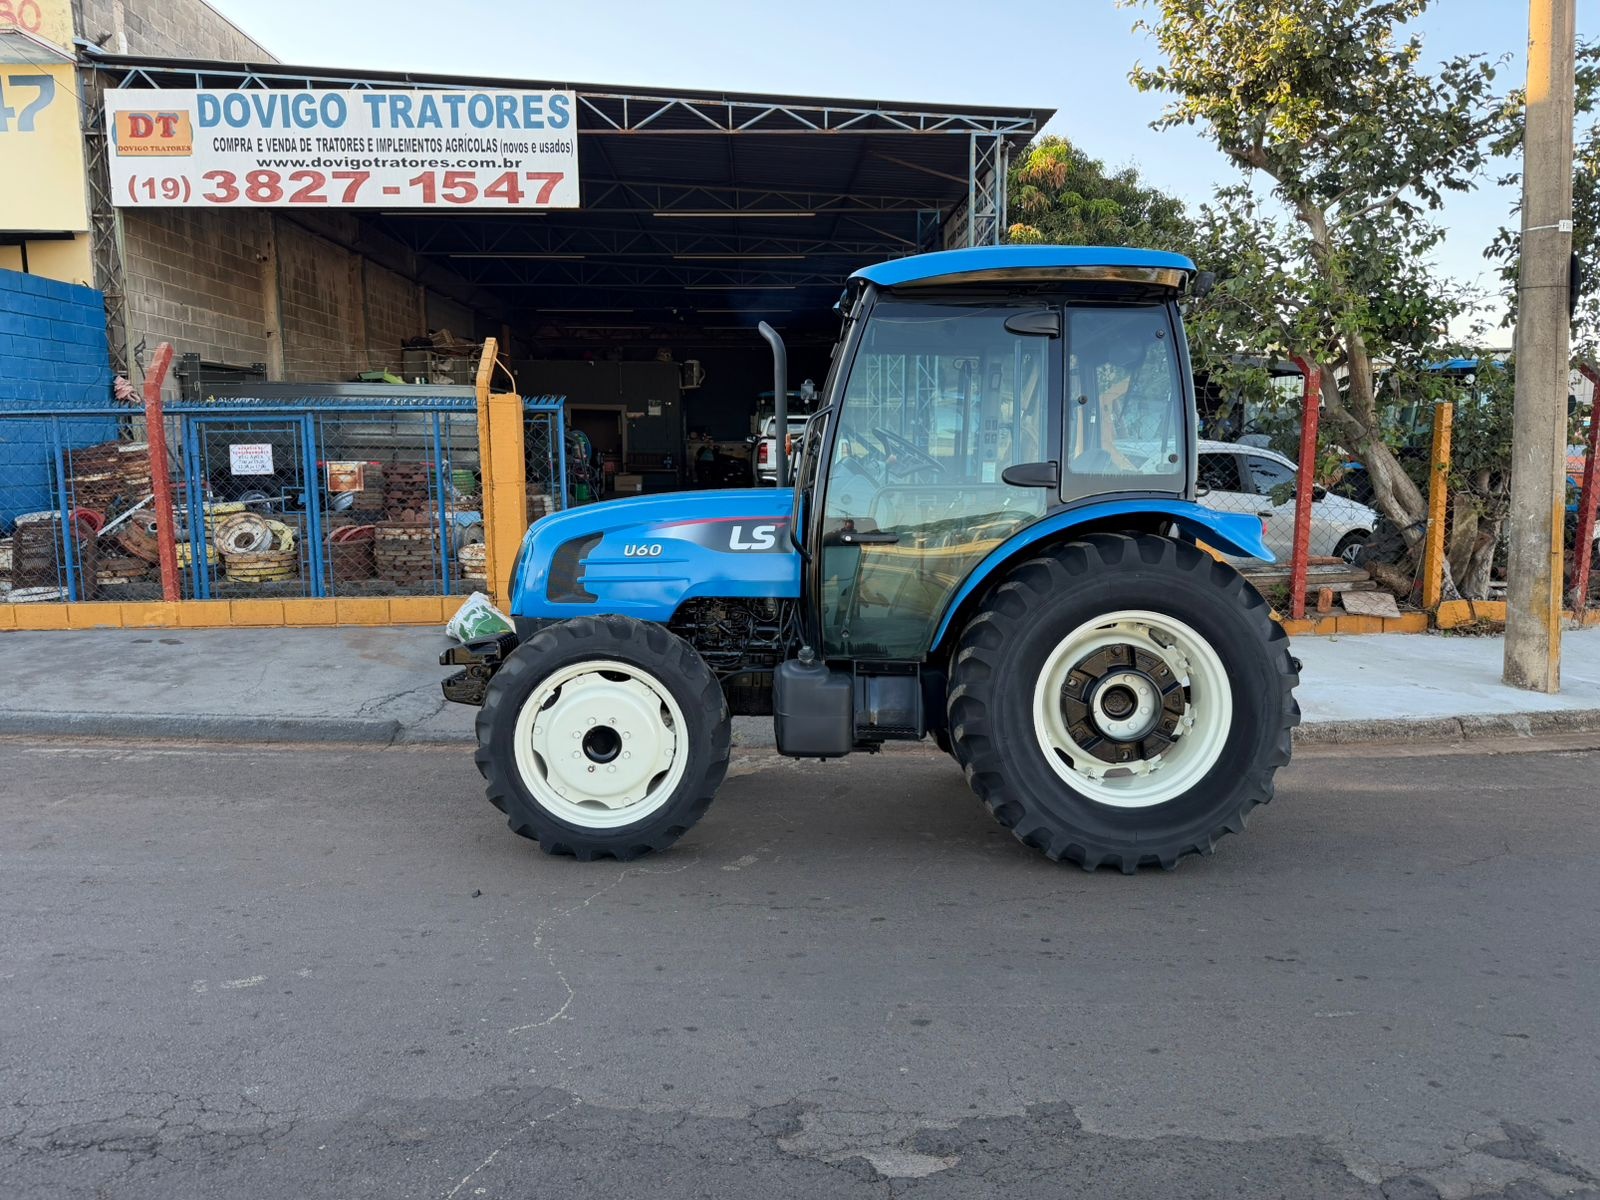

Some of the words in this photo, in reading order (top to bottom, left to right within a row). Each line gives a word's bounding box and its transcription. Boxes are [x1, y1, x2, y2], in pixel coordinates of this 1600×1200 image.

[197, 93, 347, 128] DOVIGO
[363, 94, 570, 129] TRATORES
[129, 113, 179, 138] DT
[213, 137, 252, 152] COMPRA
[257, 137, 263, 152] E
[265, 138, 297, 152] VENDA
[300, 138, 312, 152] DE
[316, 138, 365, 152] TRATORES
[368, 138, 373, 152] E
[376, 138, 442, 152] IMPLEMENTOS
[445, 133, 498, 153] AGRÍCOLAS
[500, 139, 528, 158] (novos
[531, 144, 537, 153] e
[539, 139, 574, 159] usados)
[257, 157, 522, 169] www.dovigotratores.com.br
[128, 175, 191, 203] (19)
[202, 169, 564, 204] 3827-1547
[624, 544, 662, 556] U60
[729, 525, 776, 550] LS
